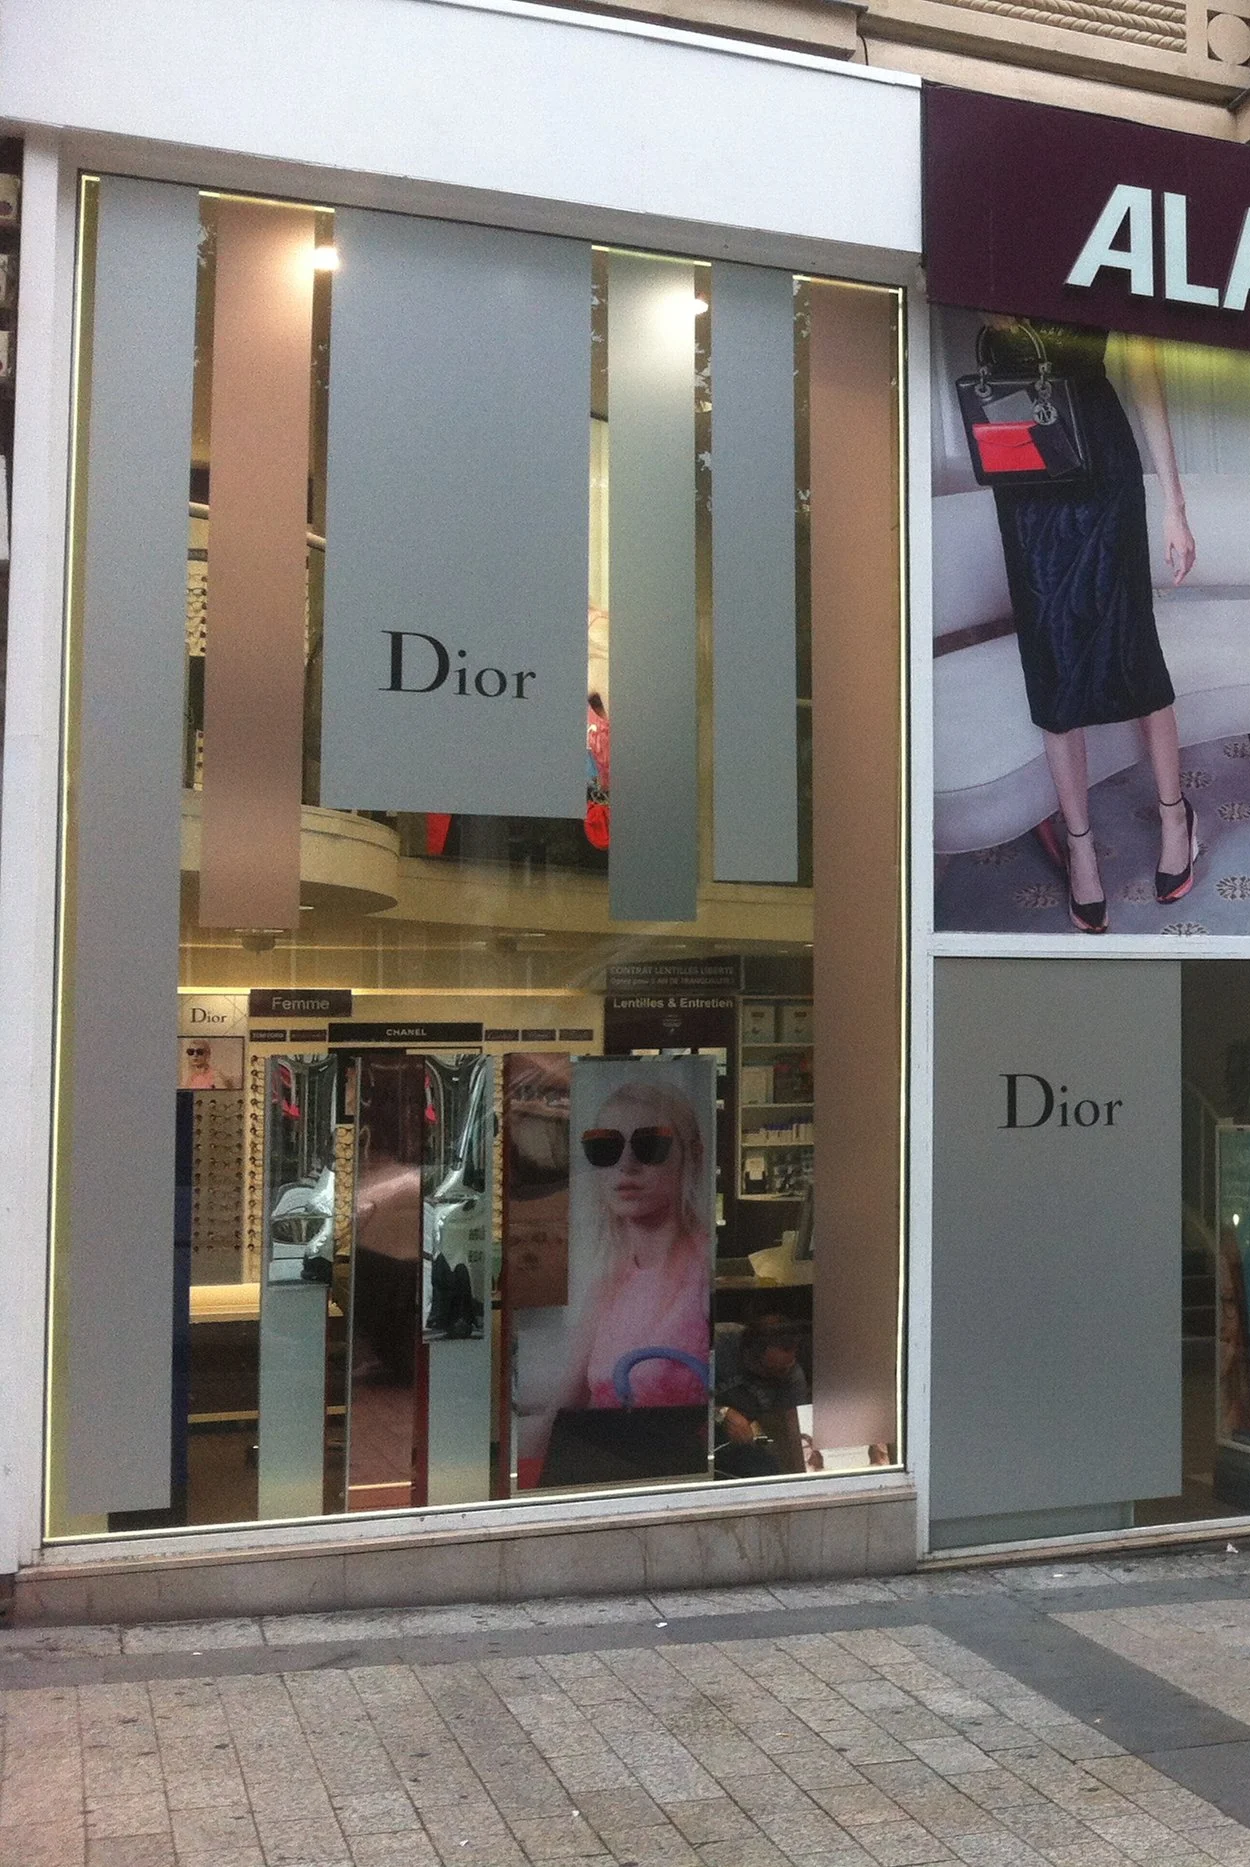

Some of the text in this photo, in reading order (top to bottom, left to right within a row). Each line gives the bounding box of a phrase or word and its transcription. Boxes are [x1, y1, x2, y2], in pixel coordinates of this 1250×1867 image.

[378, 630, 537, 700] Dior
[272, 997, 330, 1010] Femme
[613, 998, 734, 1009] Lentilles & Entretien
[190, 1007, 227, 1023] Dior
[386, 1028, 427, 1036] CHANEL
[997, 1073, 1123, 1129] Dior
